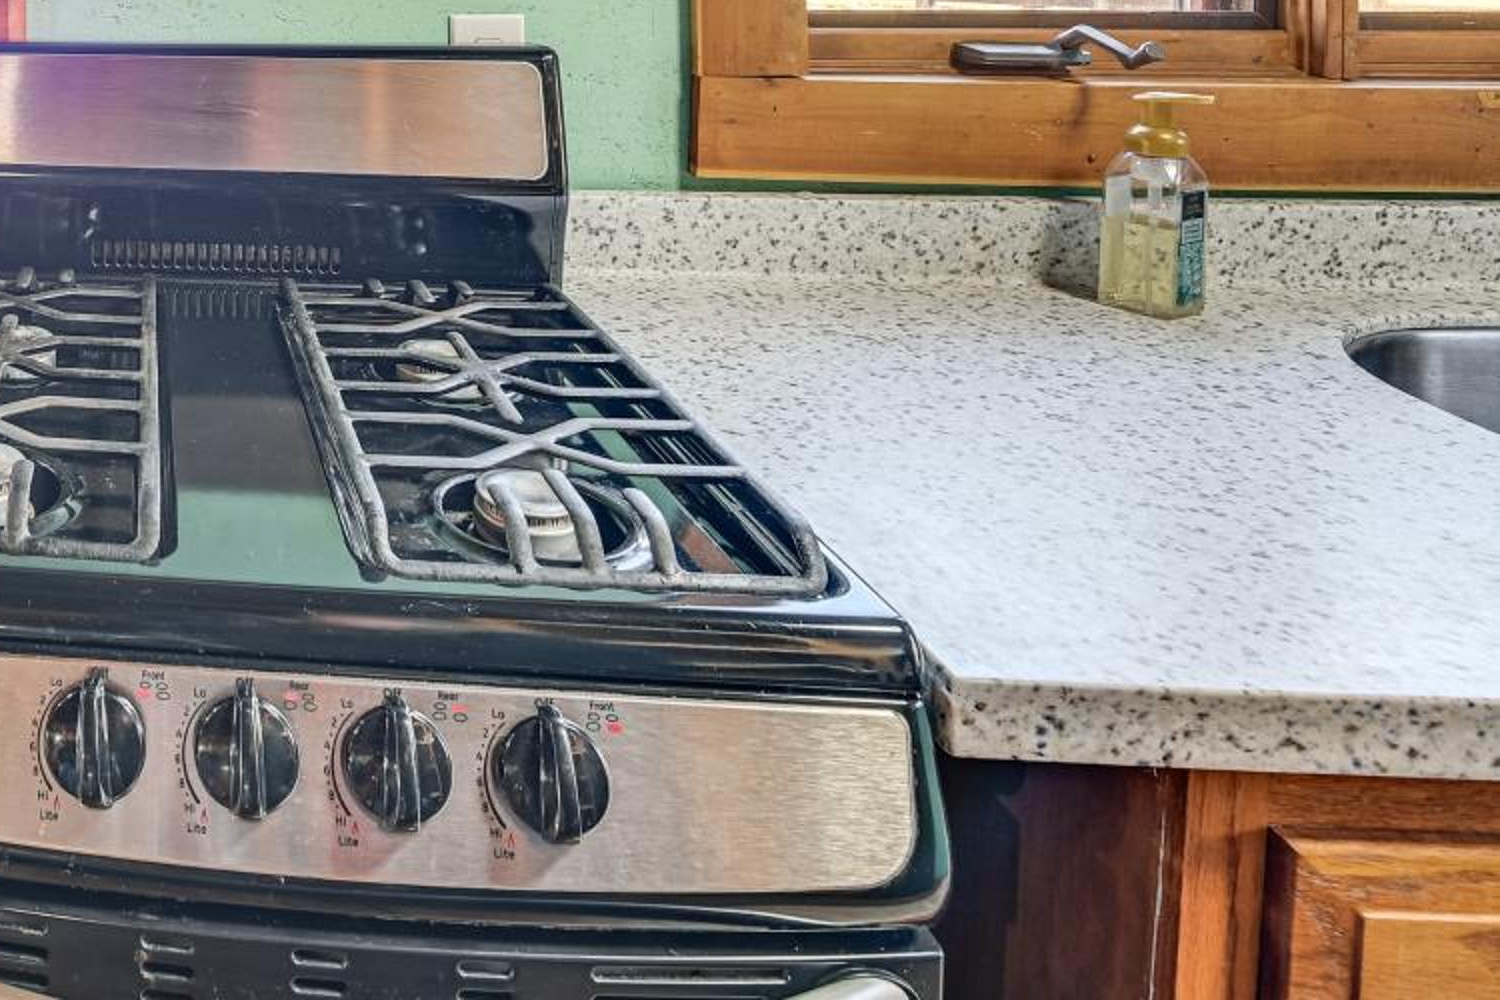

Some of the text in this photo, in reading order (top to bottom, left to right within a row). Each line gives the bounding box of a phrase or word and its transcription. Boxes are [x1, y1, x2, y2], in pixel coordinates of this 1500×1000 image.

[142, 669, 165, 680] Front
[290, 680, 309, 691] Rear
[193, 688, 206, 698] Lo
[437, 691, 459, 701] Rear
[341, 698, 353, 709] Lo
[589, 701, 615, 711] Front
[491, 709, 505, 719] Lo
[37, 790, 49, 801] Hi
[184, 802, 195, 814] Hi
[39, 810, 59, 821] Lite
[335, 816, 347, 827] Hi
[187, 824, 207, 835] Lite
[490, 827, 503, 838] Hi
[338, 836, 359, 847] Lite
[493, 848, 515, 859] Lite
